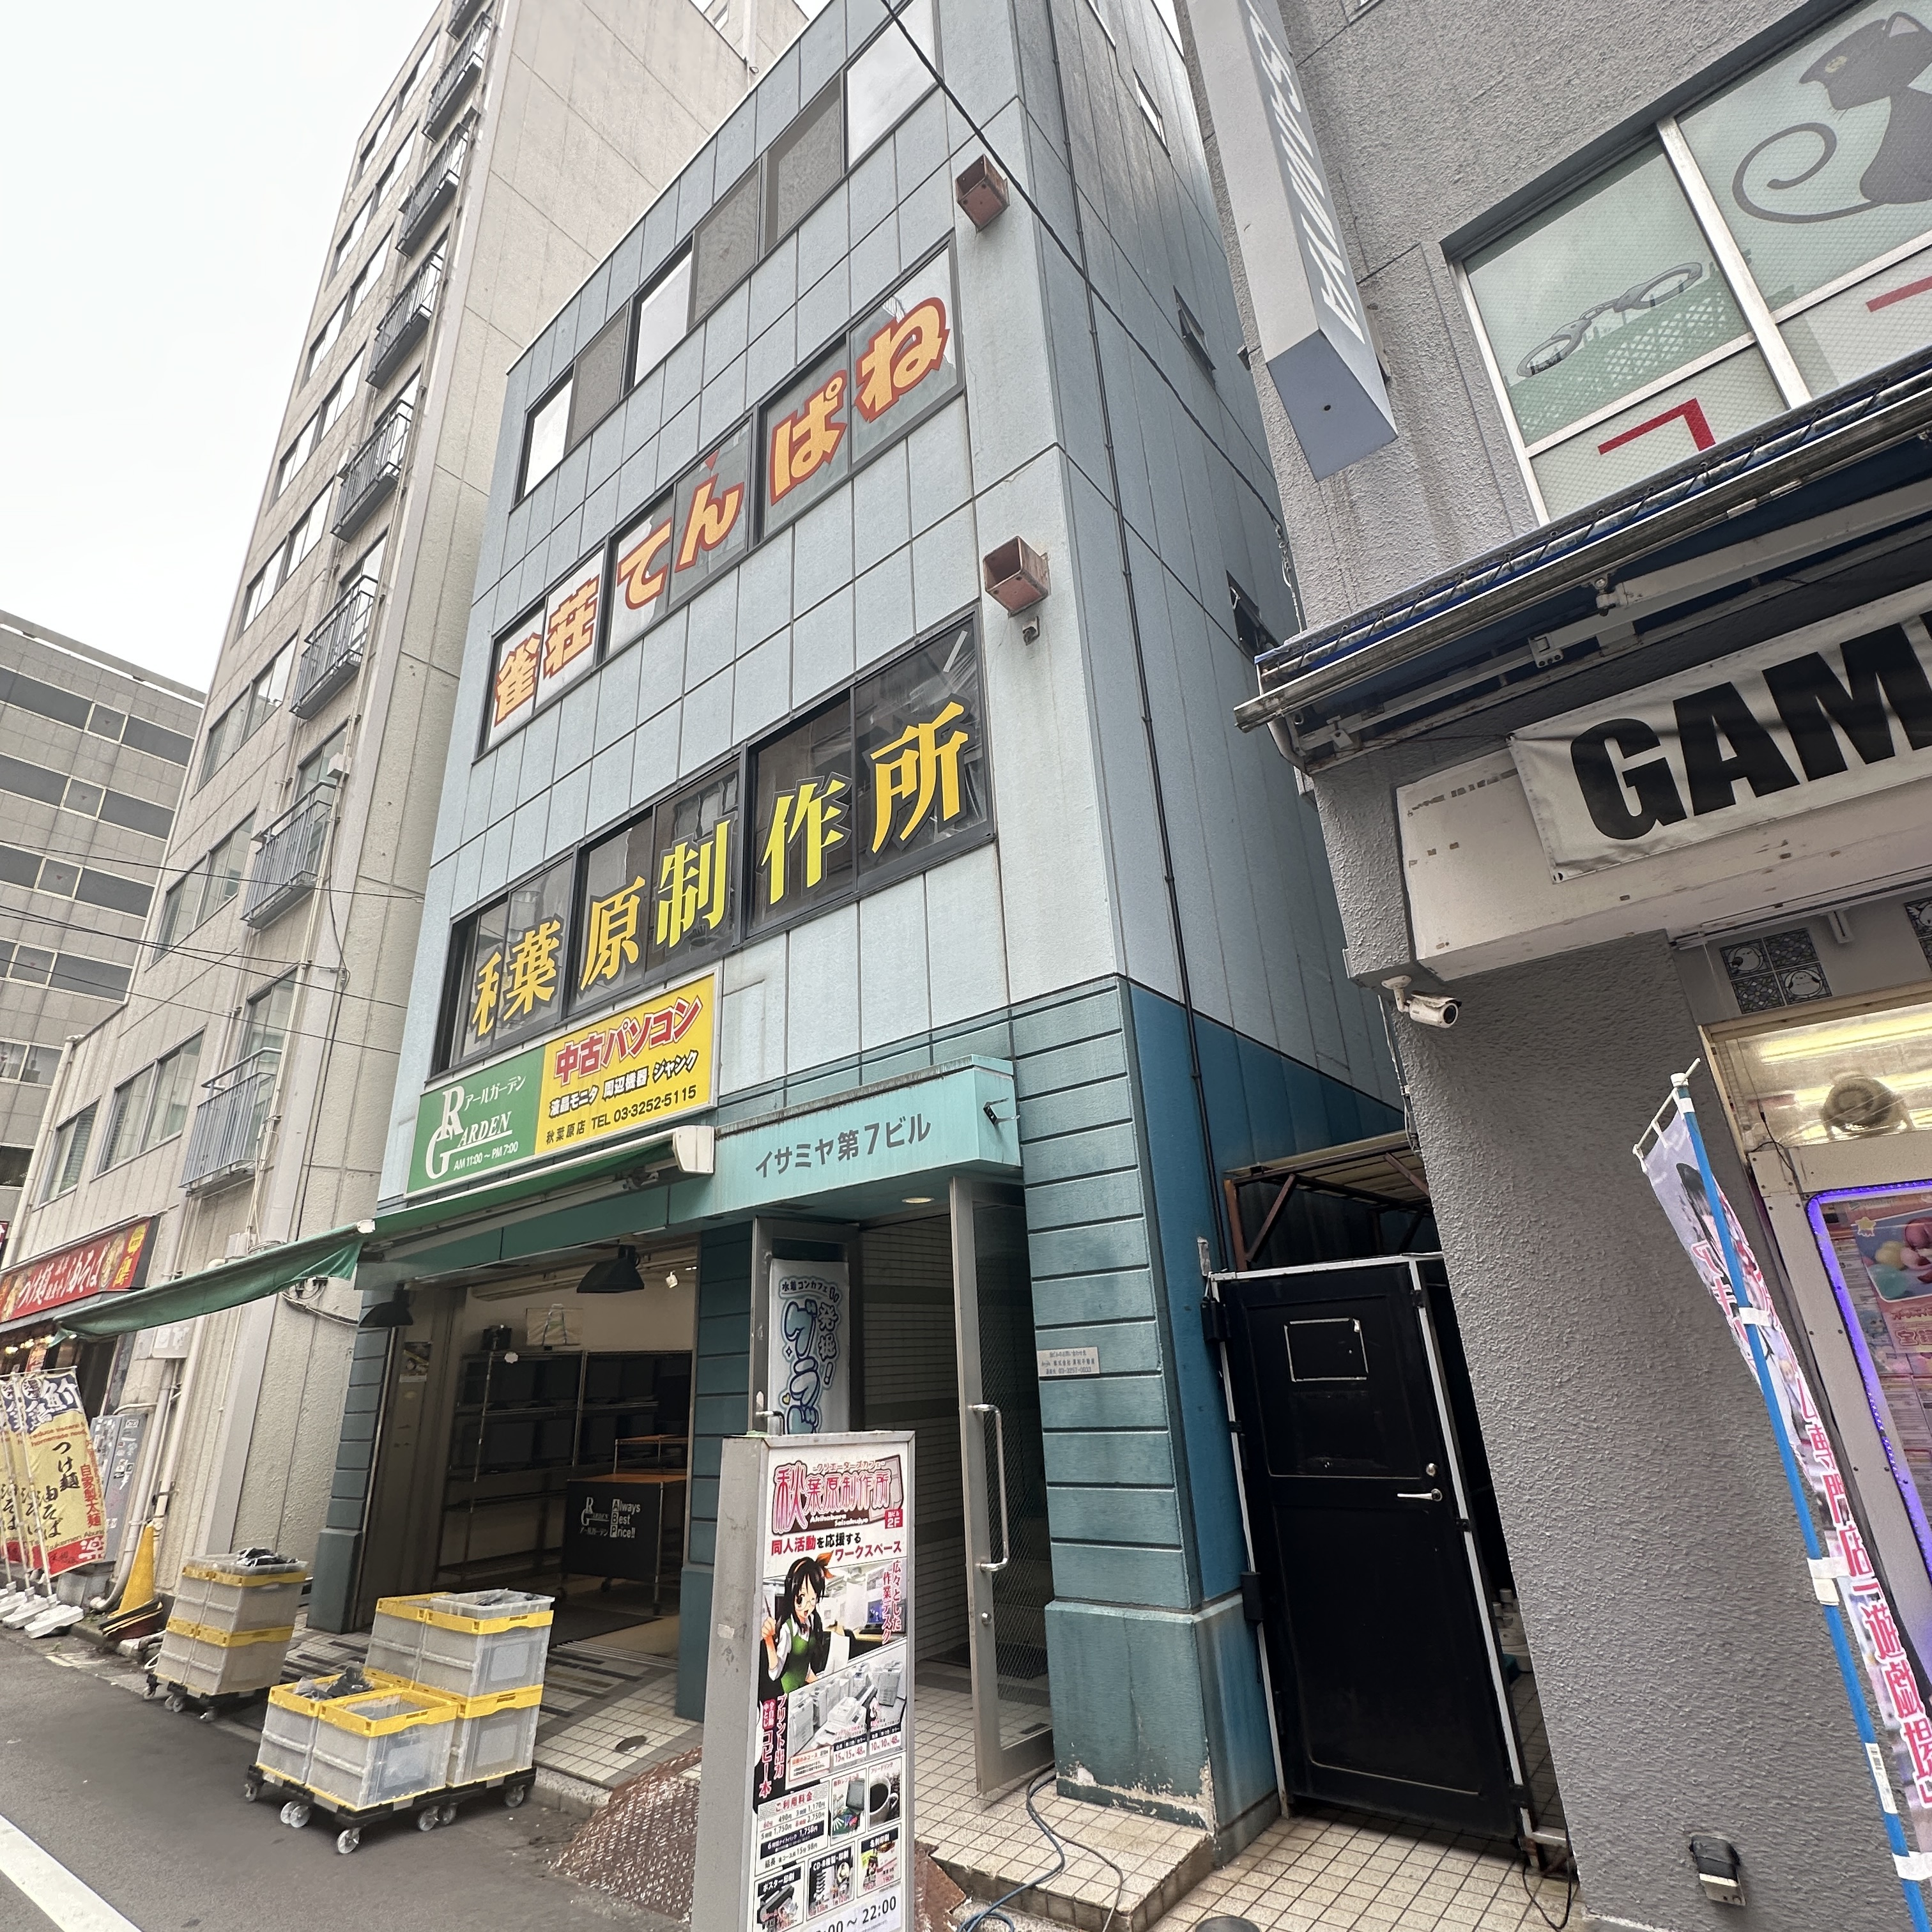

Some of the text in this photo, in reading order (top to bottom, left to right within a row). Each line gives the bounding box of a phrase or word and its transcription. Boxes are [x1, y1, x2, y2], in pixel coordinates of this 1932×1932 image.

[1570, 610, 1932, 840] GAM
[554, 995, 703, 1087] 中古パソコン
[464, 1075, 526, 1111] アールガーデン
[549, 1050, 698, 1117] 液晶モニタ 周辺機器 ジャンク
[546, 1120, 586, 1145] 秋葉原店
[592, 1114, 611, 1130] TEL
[755, 1114, 931, 1178] イサミヤ第7ビル
[453, 1158, 466, 1171] AM
[491, 1146, 502, 1160] PM
[502, 1141, 519, 1156] 7:00
[782, 1281, 828, 1293] 水着コンカフェ
[53, 1442, 80, 1491] つけ麺
[80, 1464, 102, 1528] 自家製太麺
[611, 1499, 641, 1515] Always
[772, 1460, 892, 1535] 秋葉原制作所
[611, 1512, 631, 1525] Best
[887, 1517, 900, 1528] 2F
[771, 1532, 861, 1556] 同人活動を応援する
[835, 1540, 901, 1561] ワークスペース
[882, 1571, 892, 1645] 作業デスク
[892, 1560, 901, 1632] 広々とした
[774, 1694, 788, 1780] プリント出力
[759, 1729, 774, 1799] コピー本
[870, 1761, 893, 1774] フリードリンク
[776, 1791, 813, 1812] ご利用料金
[763, 1872, 795, 1892] ポスター印刷
[862, 1896, 896, 1924] 22:00
